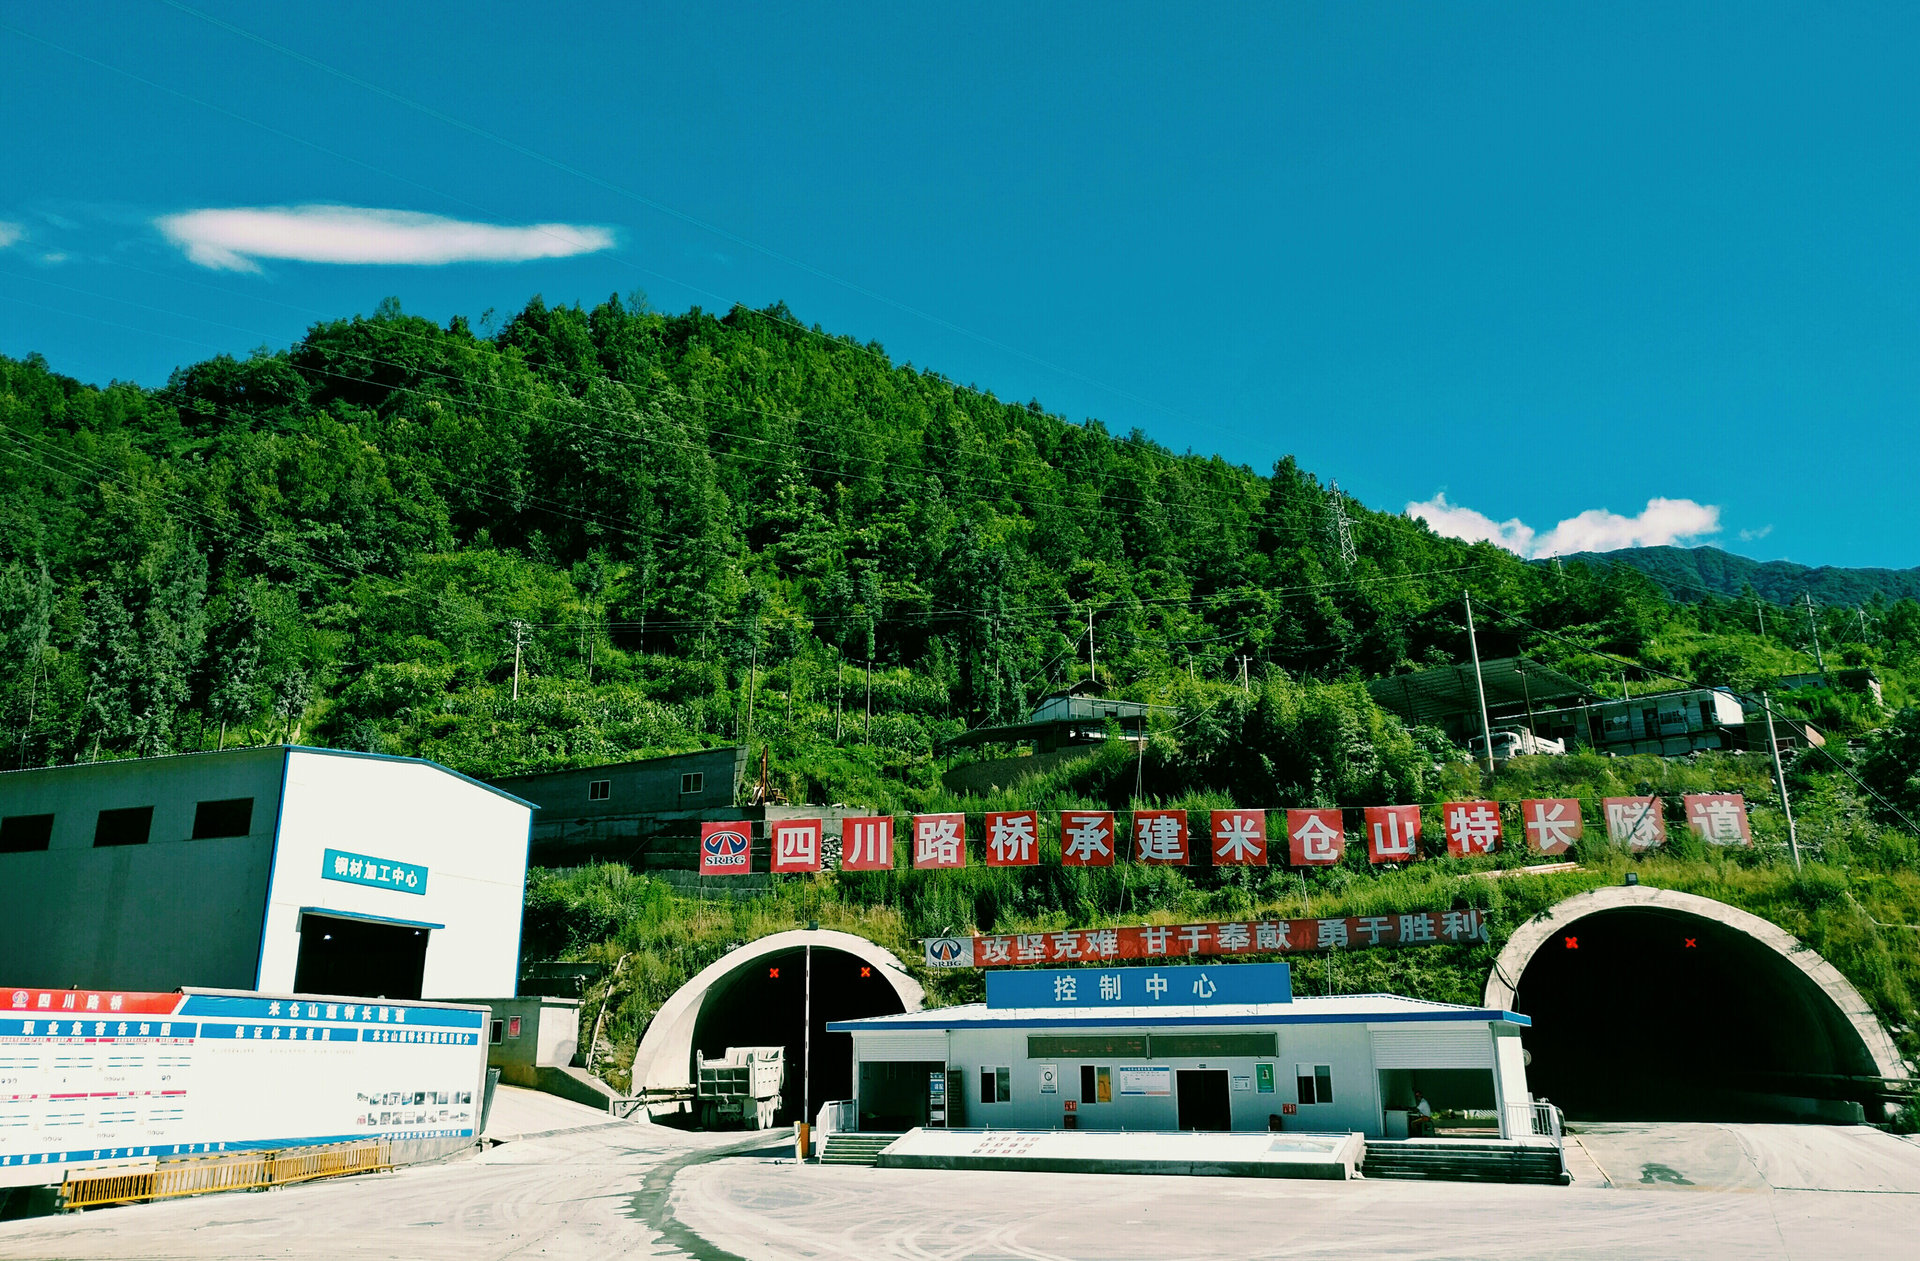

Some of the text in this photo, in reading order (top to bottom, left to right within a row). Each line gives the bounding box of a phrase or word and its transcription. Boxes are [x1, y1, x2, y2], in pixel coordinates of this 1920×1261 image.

[777, 799, 1747, 866] 四川路桥承建米仓山特长隧道
[334, 855, 418, 888] 钢材加工中心
[705, 854, 746, 866] SRBG
[981, 910, 1479, 963] 攻坚克难 甘于奉献 勇于胜利
[37, 993, 124, 1011] 四川路桥
[1053, 972, 1217, 1001] 控制中心
